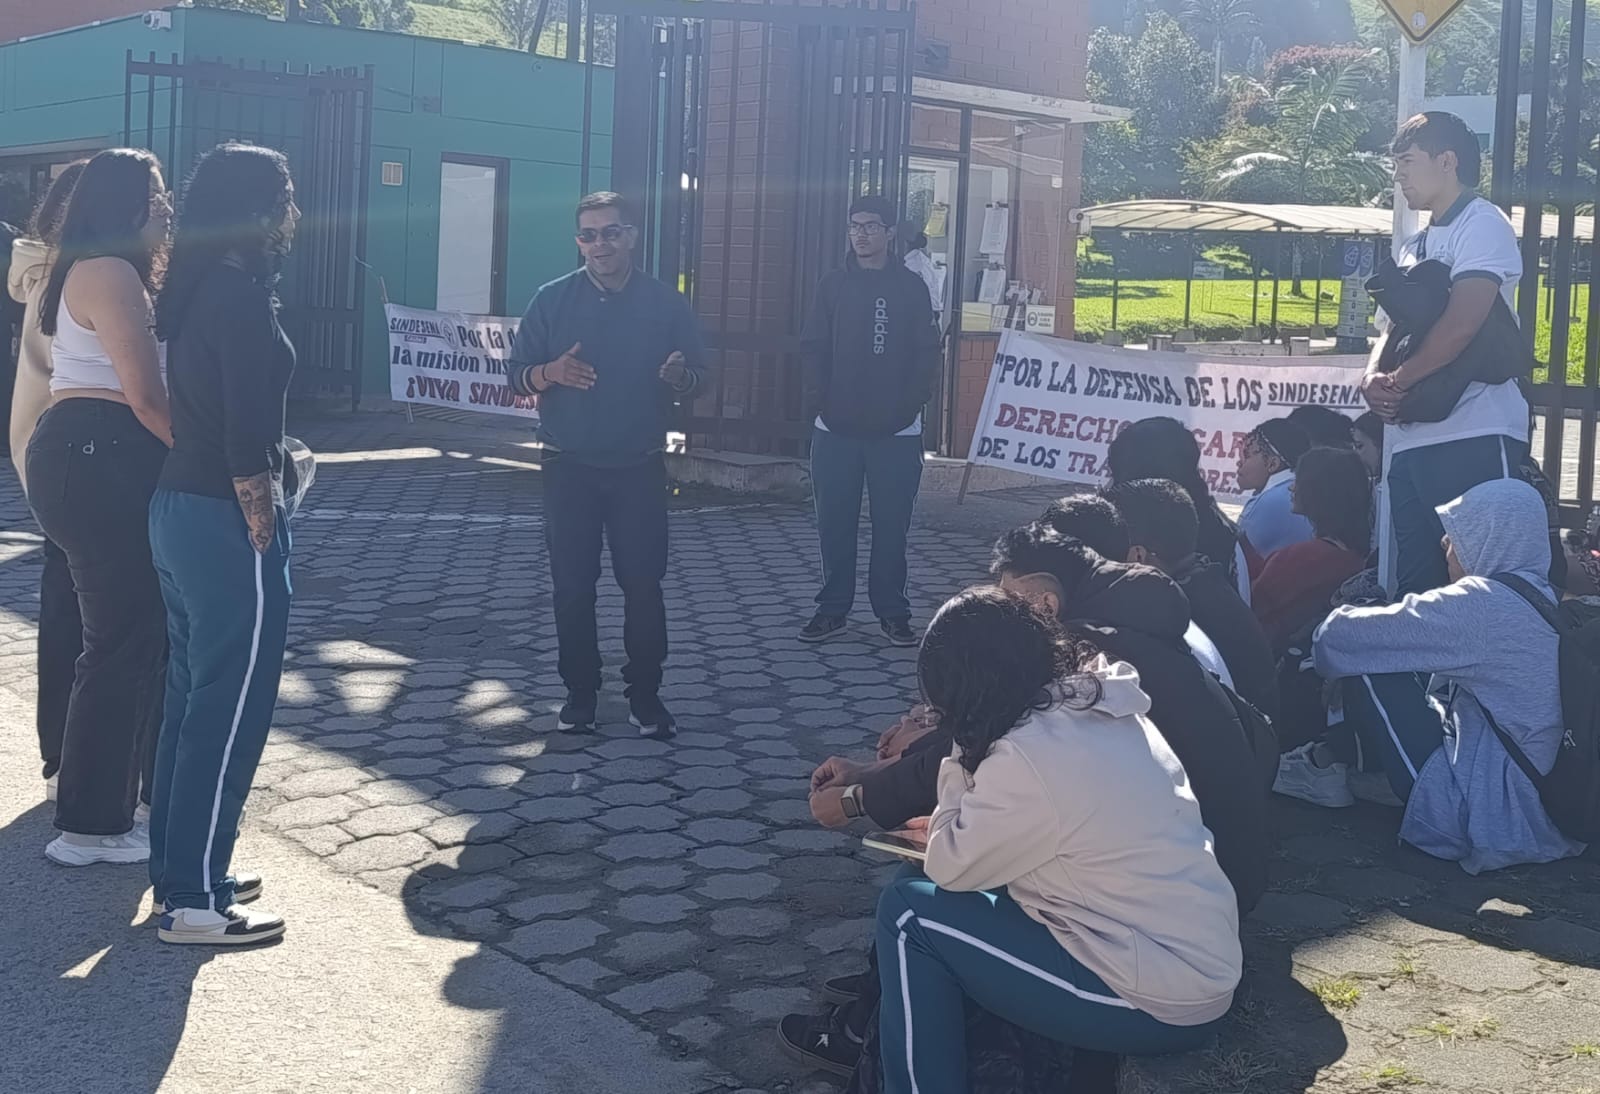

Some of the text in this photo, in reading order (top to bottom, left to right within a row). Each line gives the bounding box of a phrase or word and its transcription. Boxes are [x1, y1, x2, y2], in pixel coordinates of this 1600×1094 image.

[457, 325, 483, 349] Por
[486, 327, 505, 349] la
[874, 298, 888, 354] adidas
[392, 345, 412, 366] la
[416, 350, 480, 373] misión
[406, 375, 460, 402] ¡VIVA
[1046, 361, 1077, 394] LA
[1083, 366, 1182, 406] DEFENSA
[1184, 376, 1216, 408] DE
[1221, 376, 1263, 411] LOS
[1268, 382, 1361, 405] SINDESENA
[977, 437, 1009, 460] DE
[1014, 442, 1061, 469] LOS
